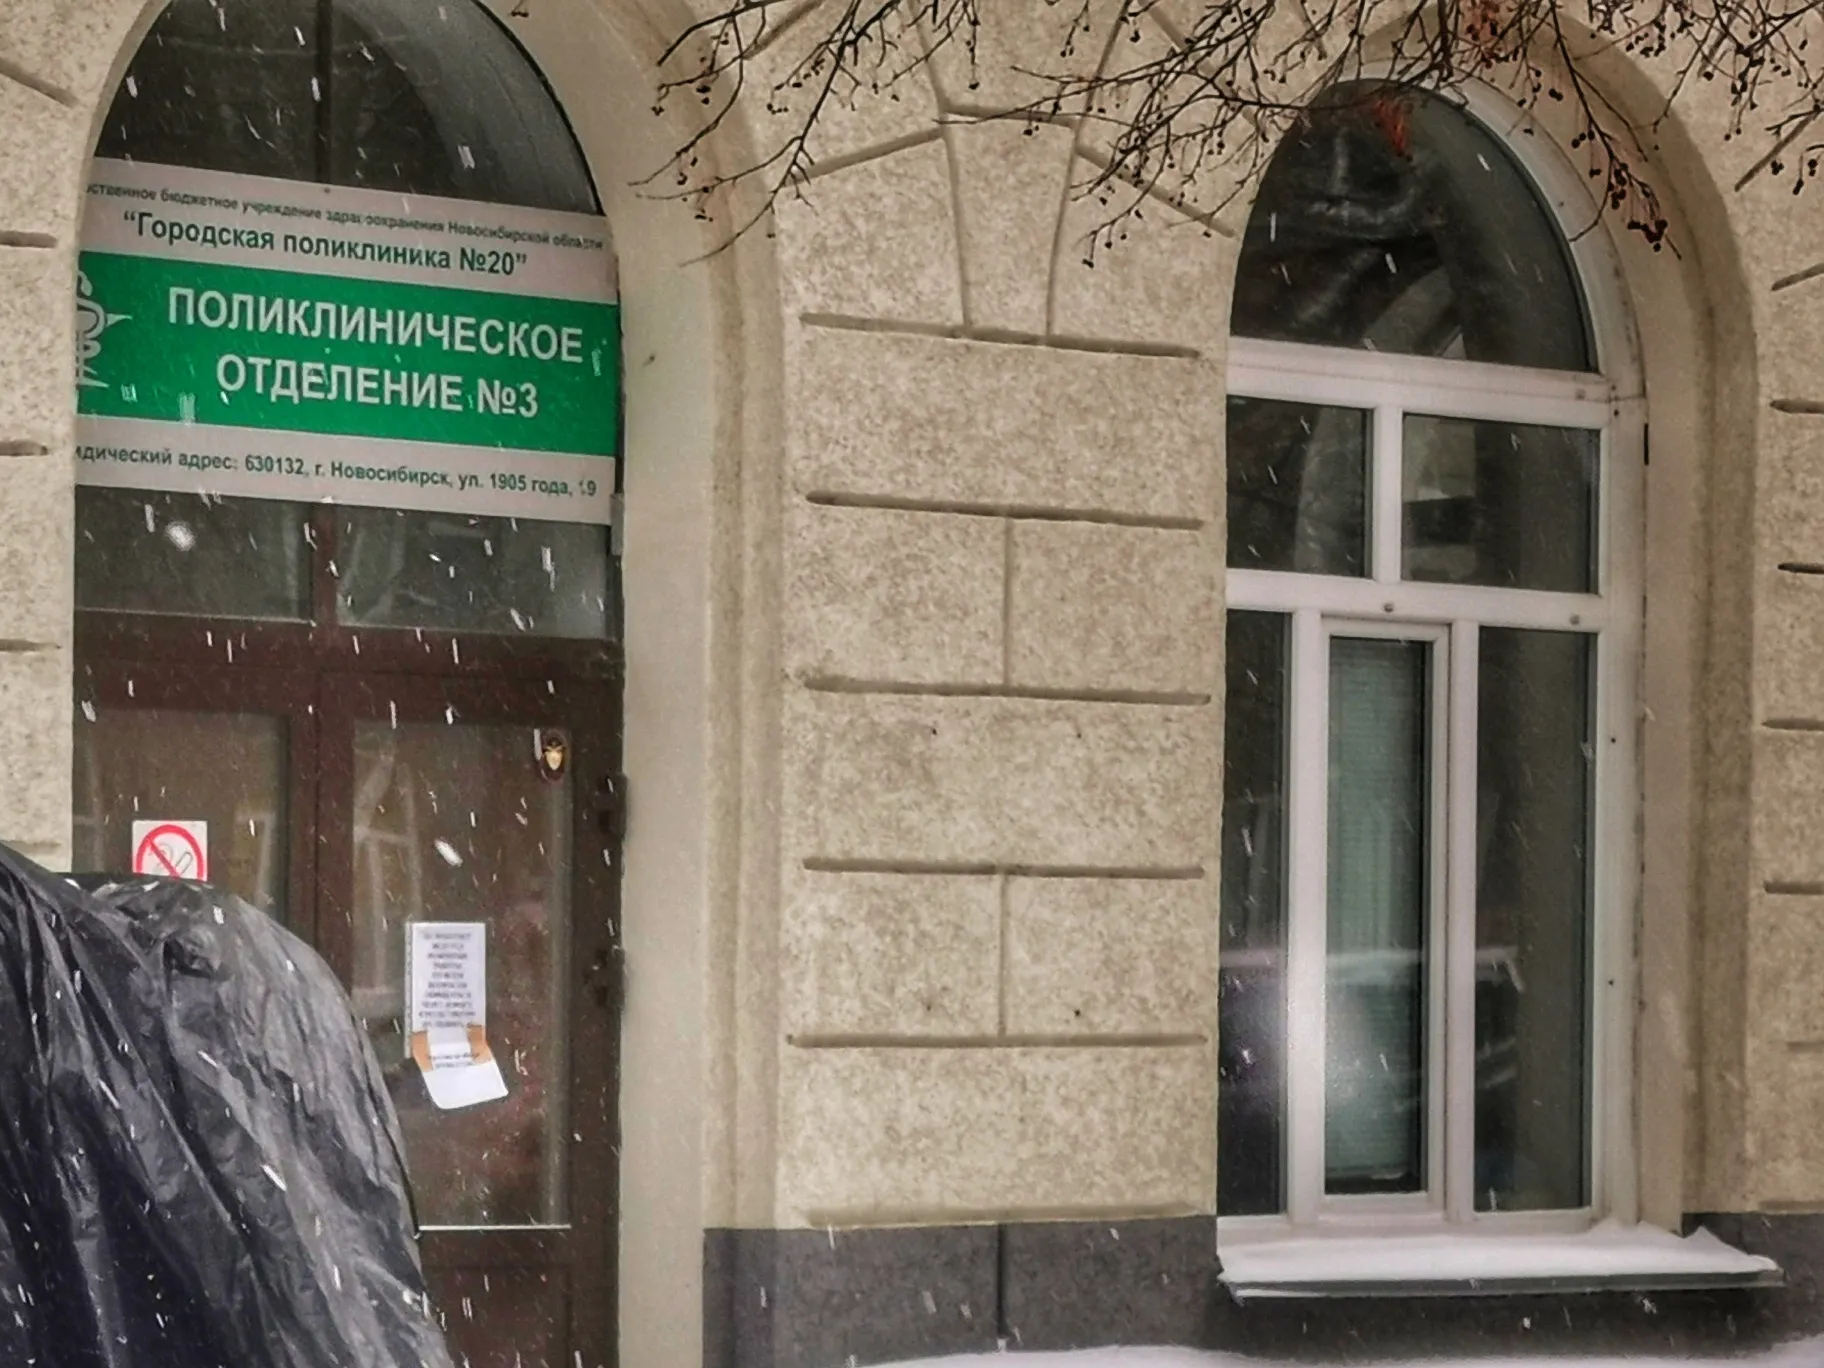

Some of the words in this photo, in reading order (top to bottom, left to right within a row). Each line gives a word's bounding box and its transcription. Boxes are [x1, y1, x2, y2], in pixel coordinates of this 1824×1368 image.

[160, 188, 239, 209] бюджетное
[242, 198, 322, 220] учреждение
[448, 221, 550, 245] Новосибирской
[283, 233, 452, 270] поликлиника
[168, 286, 584, 364] ПОЛИКЛИНИЧЕСКОЕ
[217, 353, 464, 413] ОТДЕЛЕНИЕ
[477, 380, 539, 419] №3
[245, 454, 310, 477] 630132,
[330, 461, 453, 488] Новосибирск,
[458, 473, 484, 491] ул.
[489, 473, 527, 492] 1905
[531, 479, 573, 498] года,
